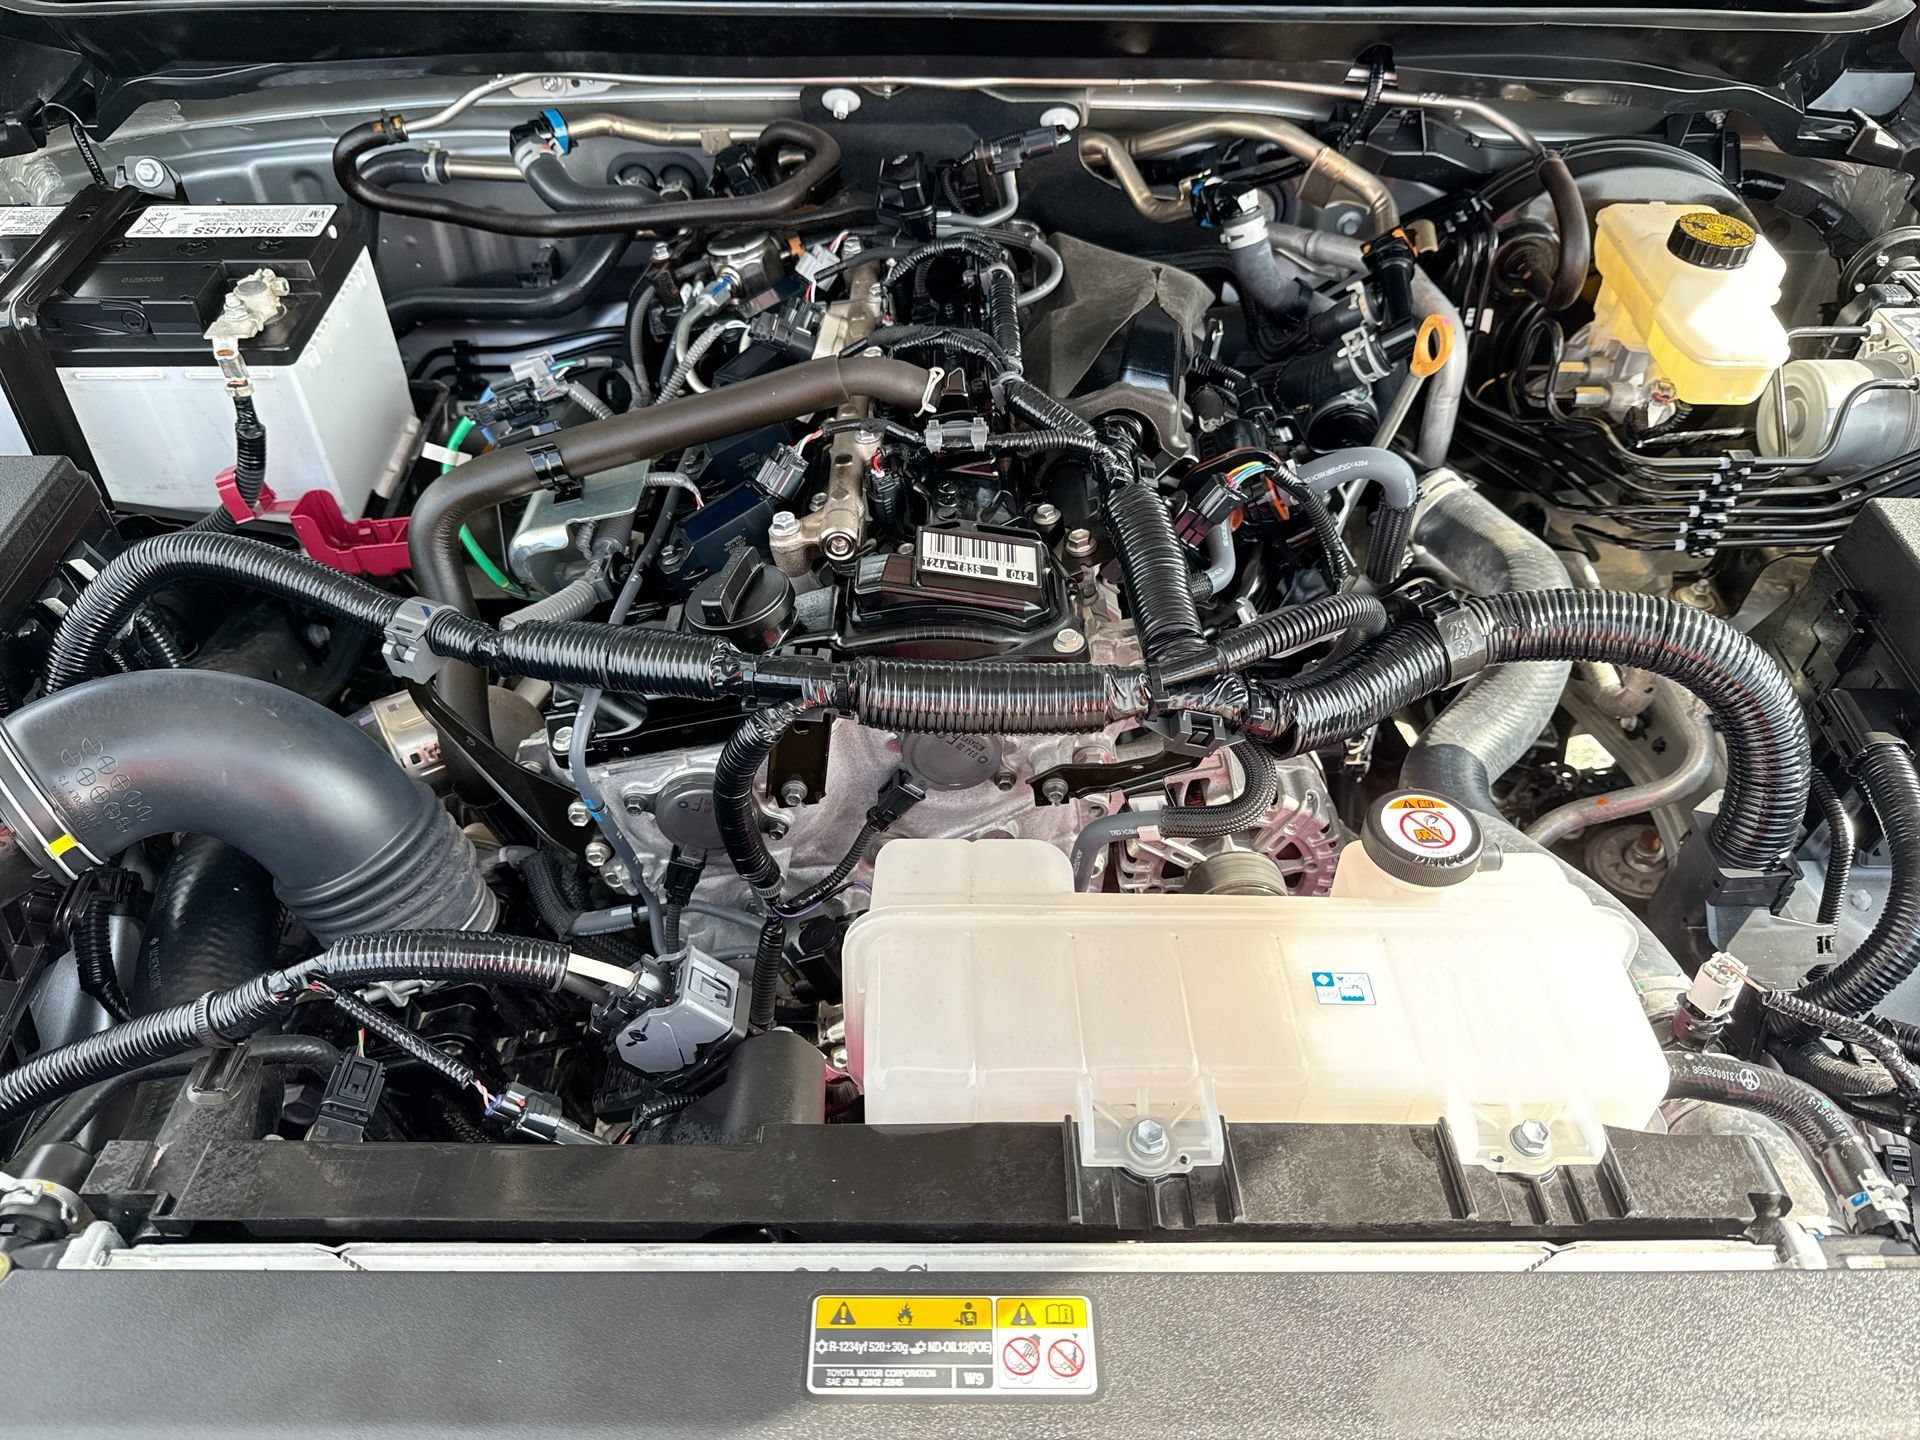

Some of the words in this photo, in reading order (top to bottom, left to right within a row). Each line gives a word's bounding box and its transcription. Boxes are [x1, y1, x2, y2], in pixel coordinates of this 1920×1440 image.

[308, 209, 325, 218] VM
[192, 226, 286, 236] 395LN4-ISS
[923, 558, 982, 575] T24A-T83S
[1010, 570, 1029, 581] 042
[829, 1341, 868, 1355] R-1234yf
[868, 1341, 909, 1355] 520±30g
[826, 1369, 855, 1377] TOYOTA
[857, 1369, 883, 1377] MOTOR
[885, 1369, 936, 1378] CORPORATION
[963, 1371, 985, 1385] W9
[825, 1378, 841, 1386] SAE
